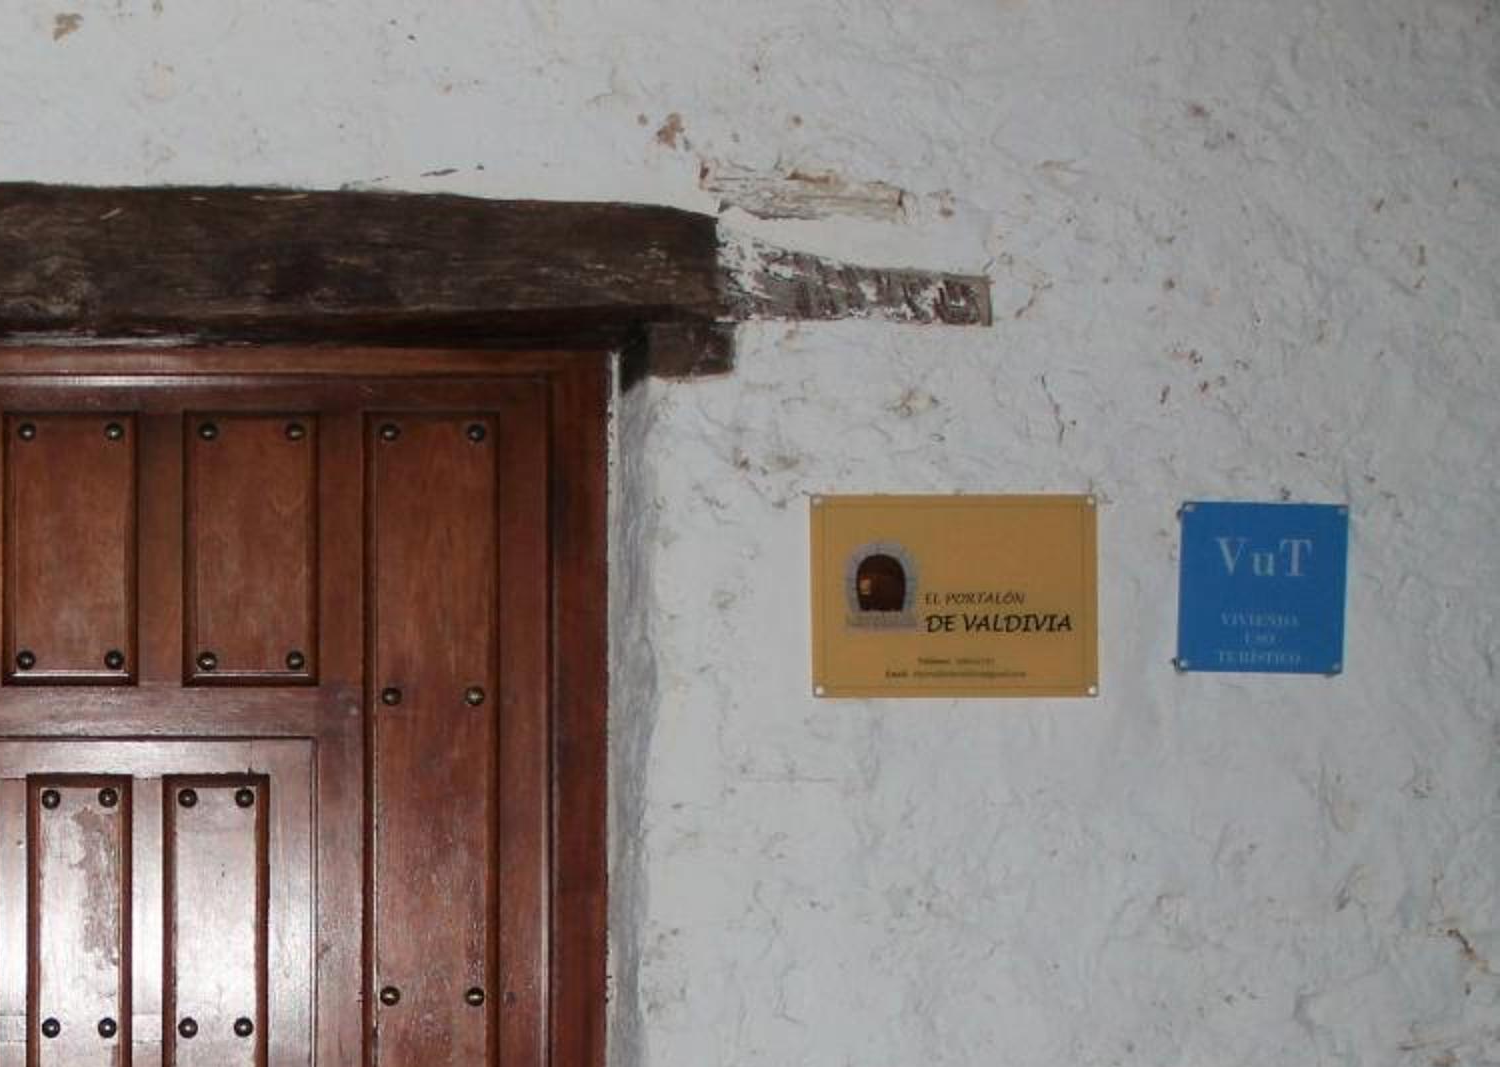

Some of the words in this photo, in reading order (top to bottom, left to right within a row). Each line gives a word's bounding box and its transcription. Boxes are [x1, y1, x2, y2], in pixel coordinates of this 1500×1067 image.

[1216, 537, 1313, 577] VuT
[925, 592, 940, 605] EL
[946, 591, 1026, 605] PORTALÓN
[925, 613, 956, 632] DE
[963, 613, 1073, 632] VALDIVIA
